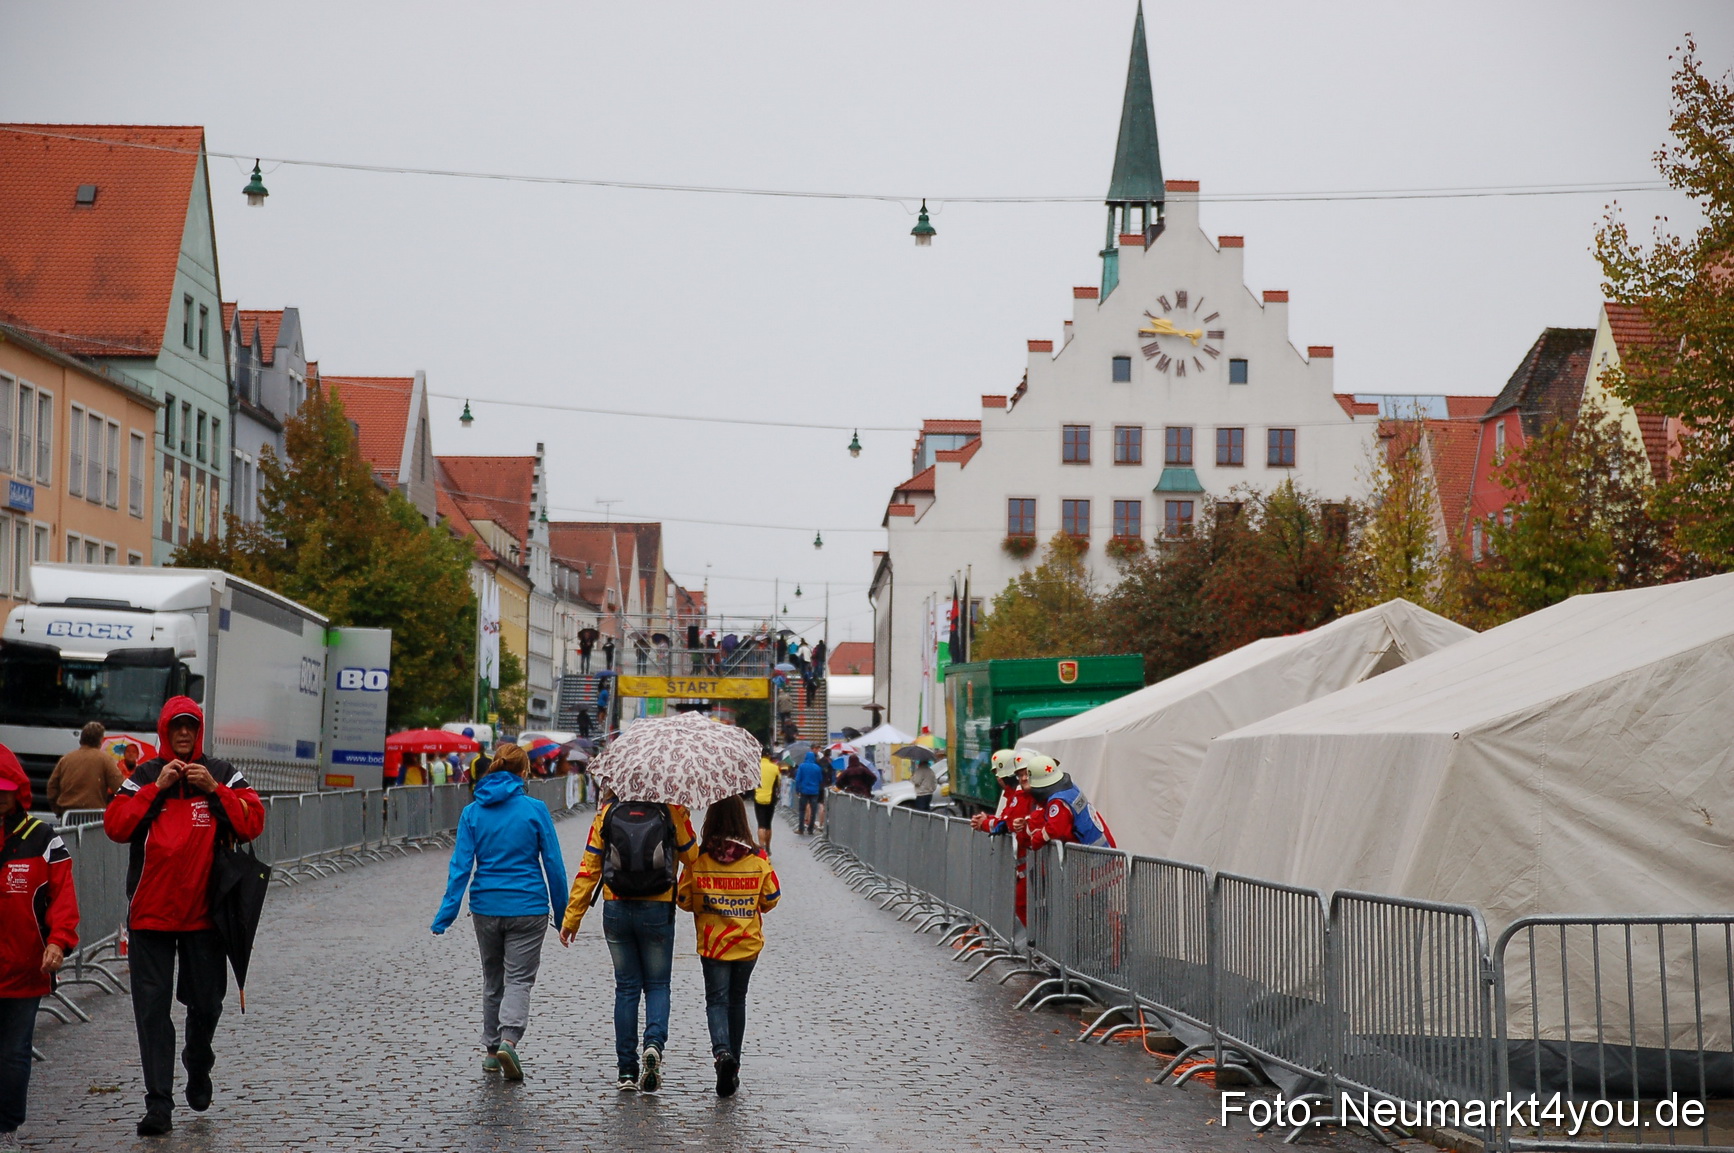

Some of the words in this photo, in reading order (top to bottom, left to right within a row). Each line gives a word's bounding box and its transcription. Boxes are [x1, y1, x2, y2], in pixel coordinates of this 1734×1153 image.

[47, 621, 134, 640] BOCK
[667, 681, 718, 693] START
[713, 877, 759, 890] NEUKIRCHEN
[703, 895, 755, 908] Radsport
